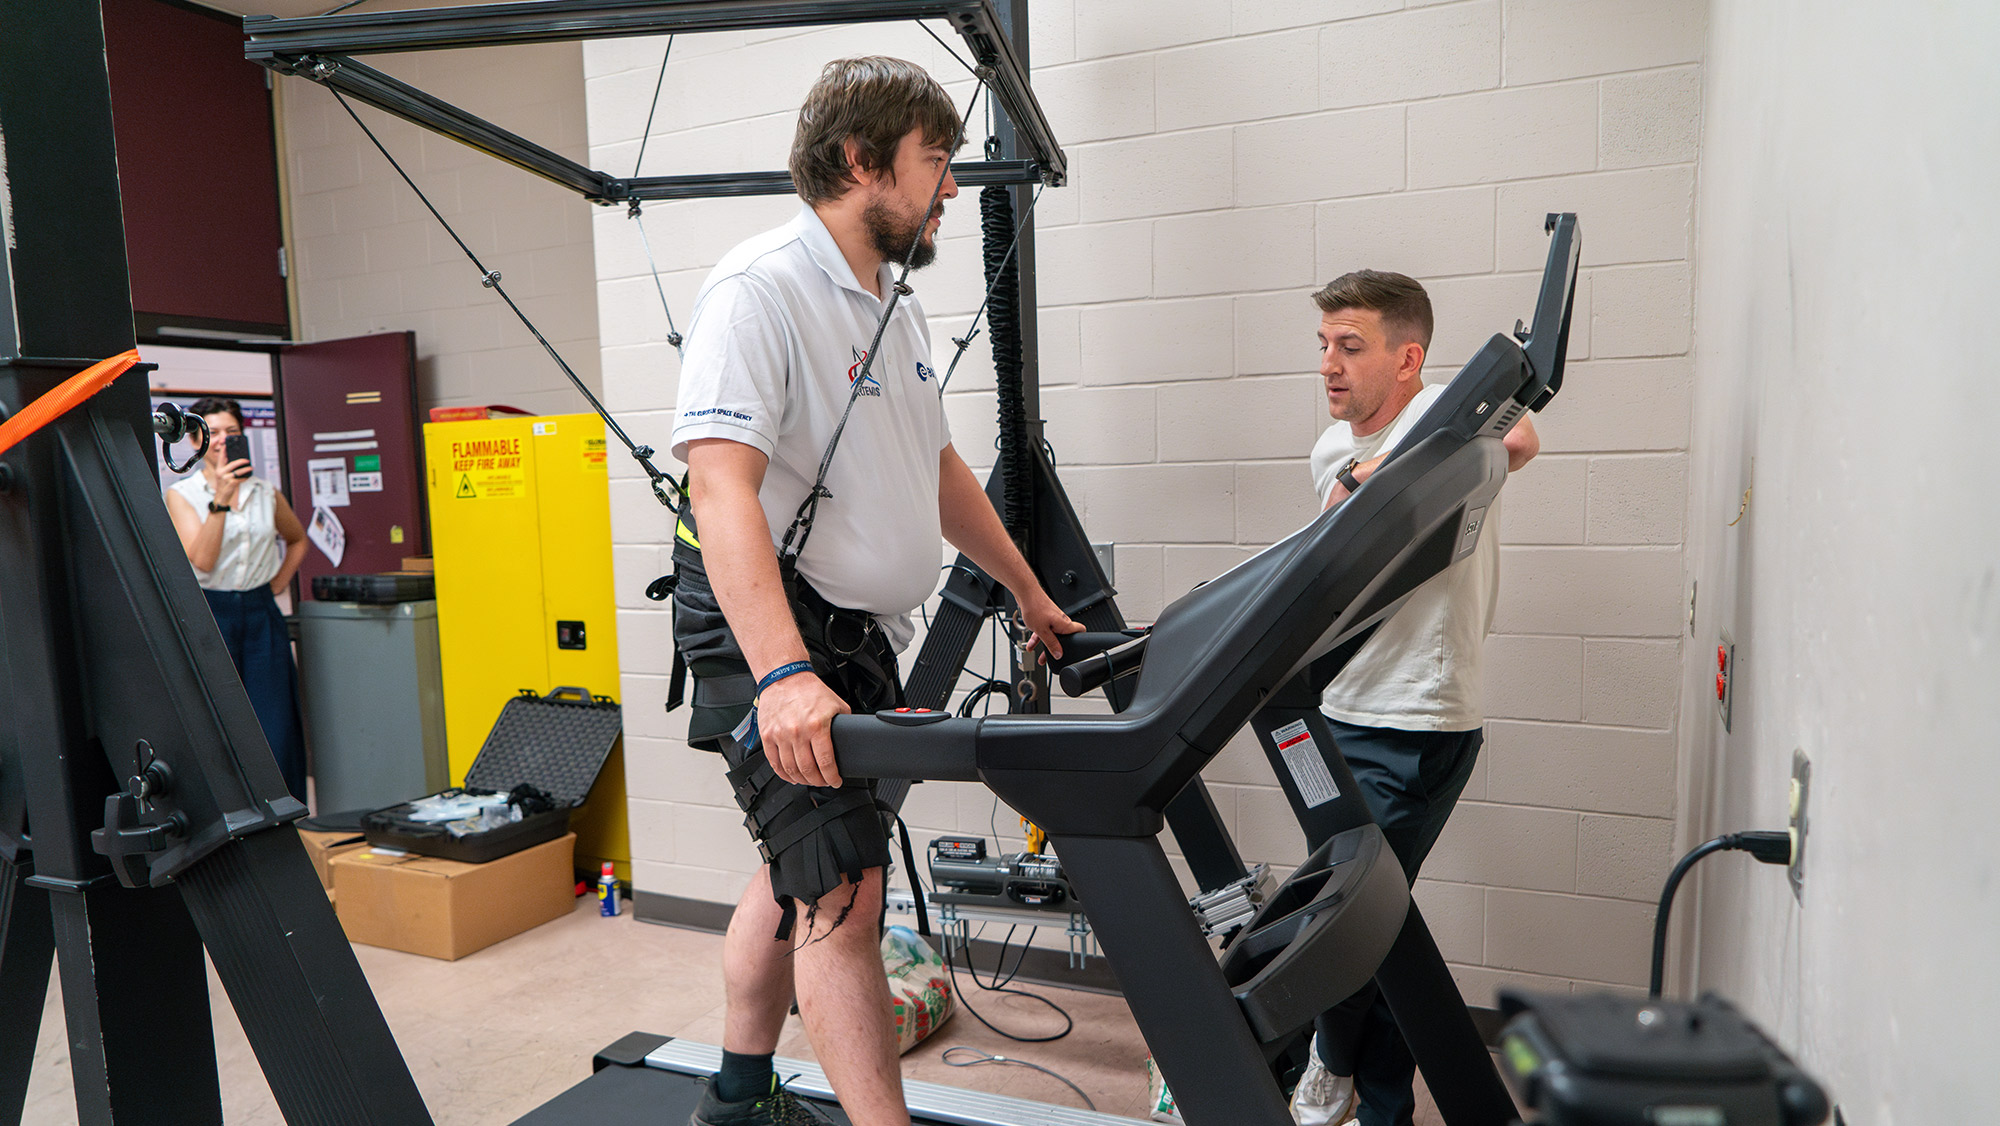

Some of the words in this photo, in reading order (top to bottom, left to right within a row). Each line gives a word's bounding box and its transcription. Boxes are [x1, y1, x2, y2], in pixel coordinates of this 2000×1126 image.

[717, 408, 733, 417] SPACE
[733, 411, 753, 422] AGENCY
[452, 438, 520, 458] FLAMMABLE
[453, 459, 475, 472] KEEP
[476, 458, 495, 471] FIRE
[497, 457, 521, 469] AWAY
[770, 667, 790, 679] AGENCY
